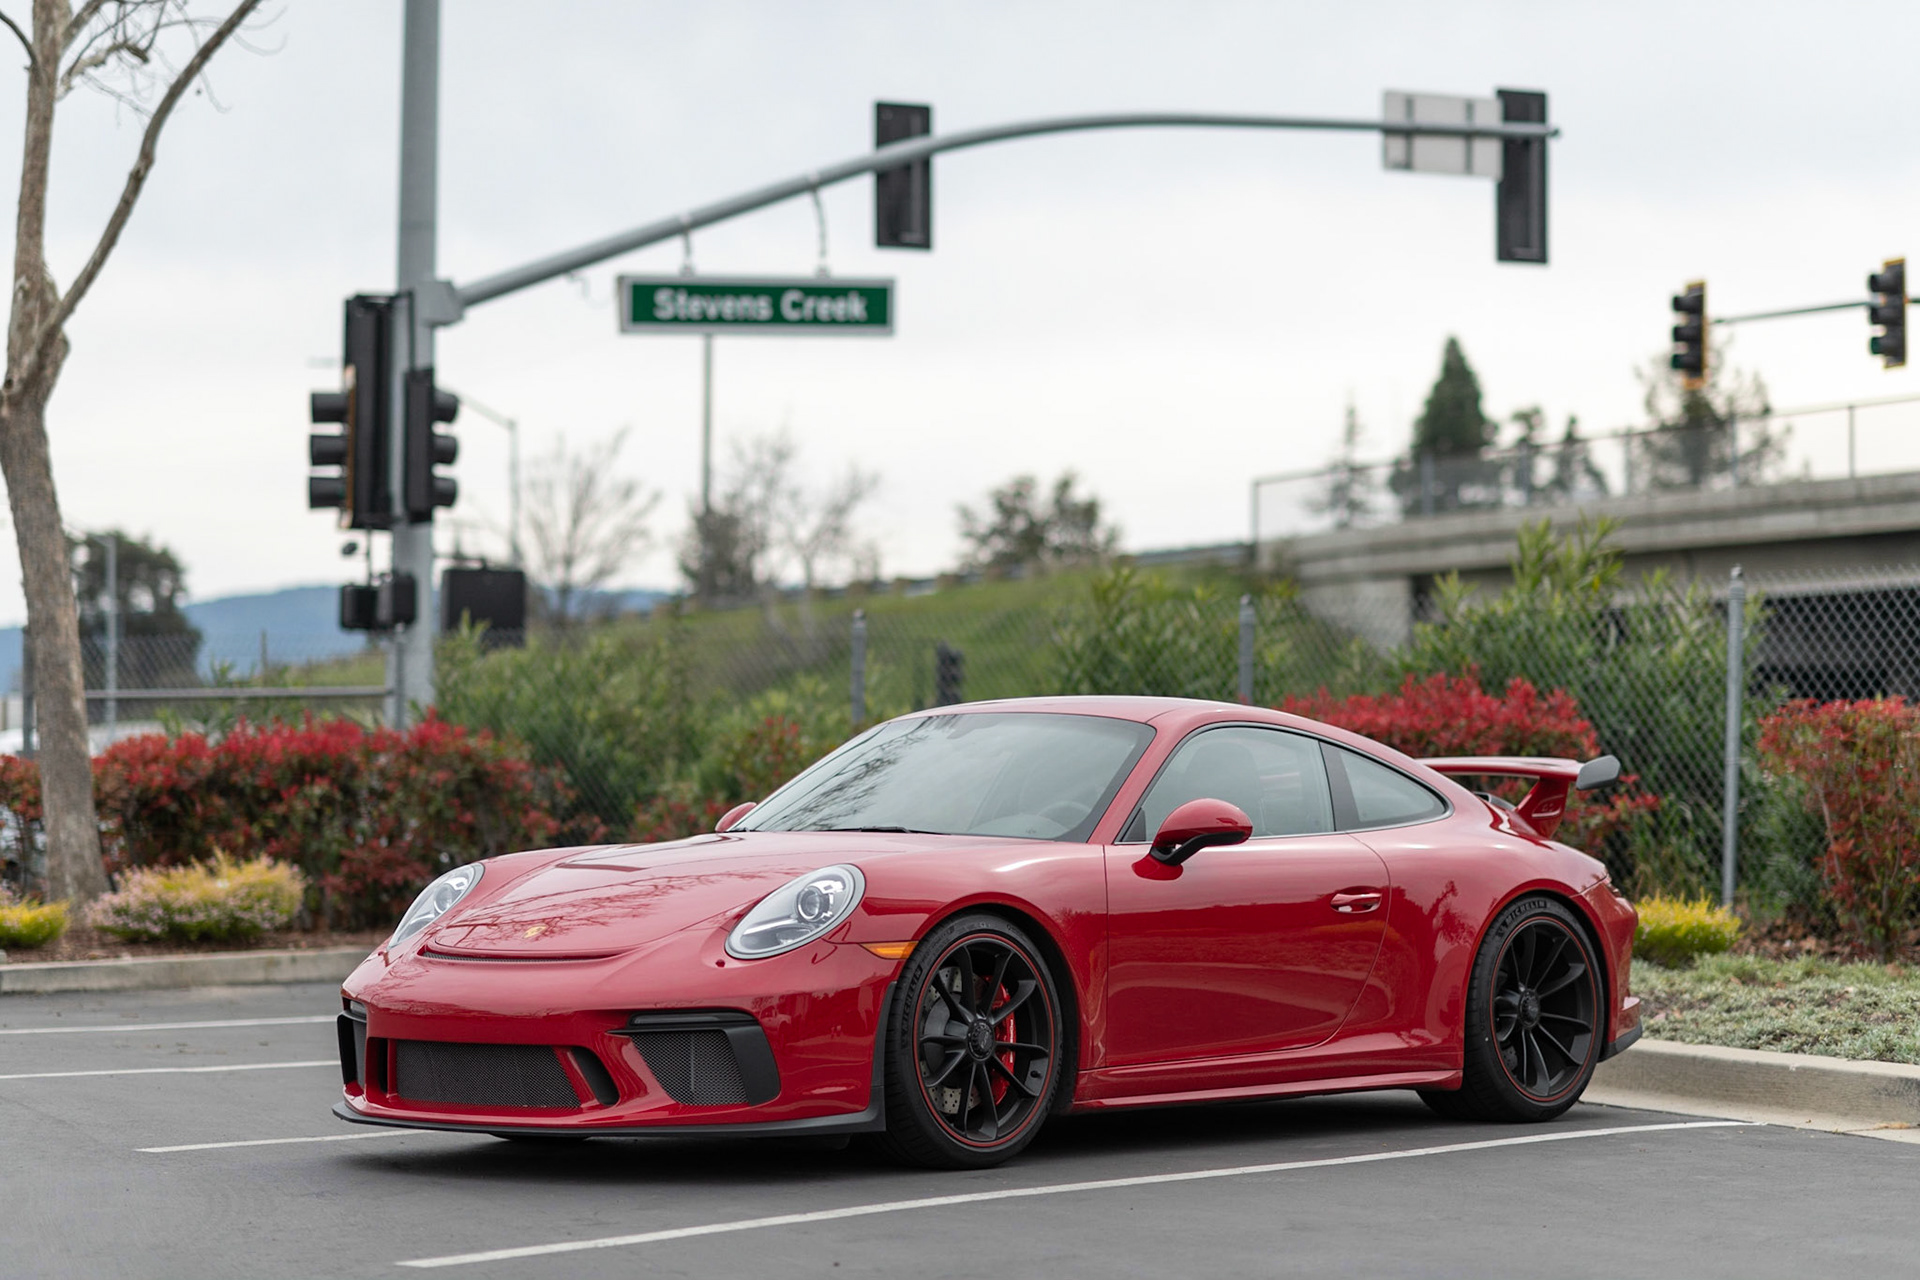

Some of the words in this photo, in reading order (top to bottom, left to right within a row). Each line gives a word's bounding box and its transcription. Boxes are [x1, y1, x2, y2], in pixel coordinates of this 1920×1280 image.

[653, 288, 773, 321] Stevens
[780, 289, 868, 321] Creek
[1504, 900, 1547, 927] MICHELIN
[901, 964, 923, 1034] MICHELIN
